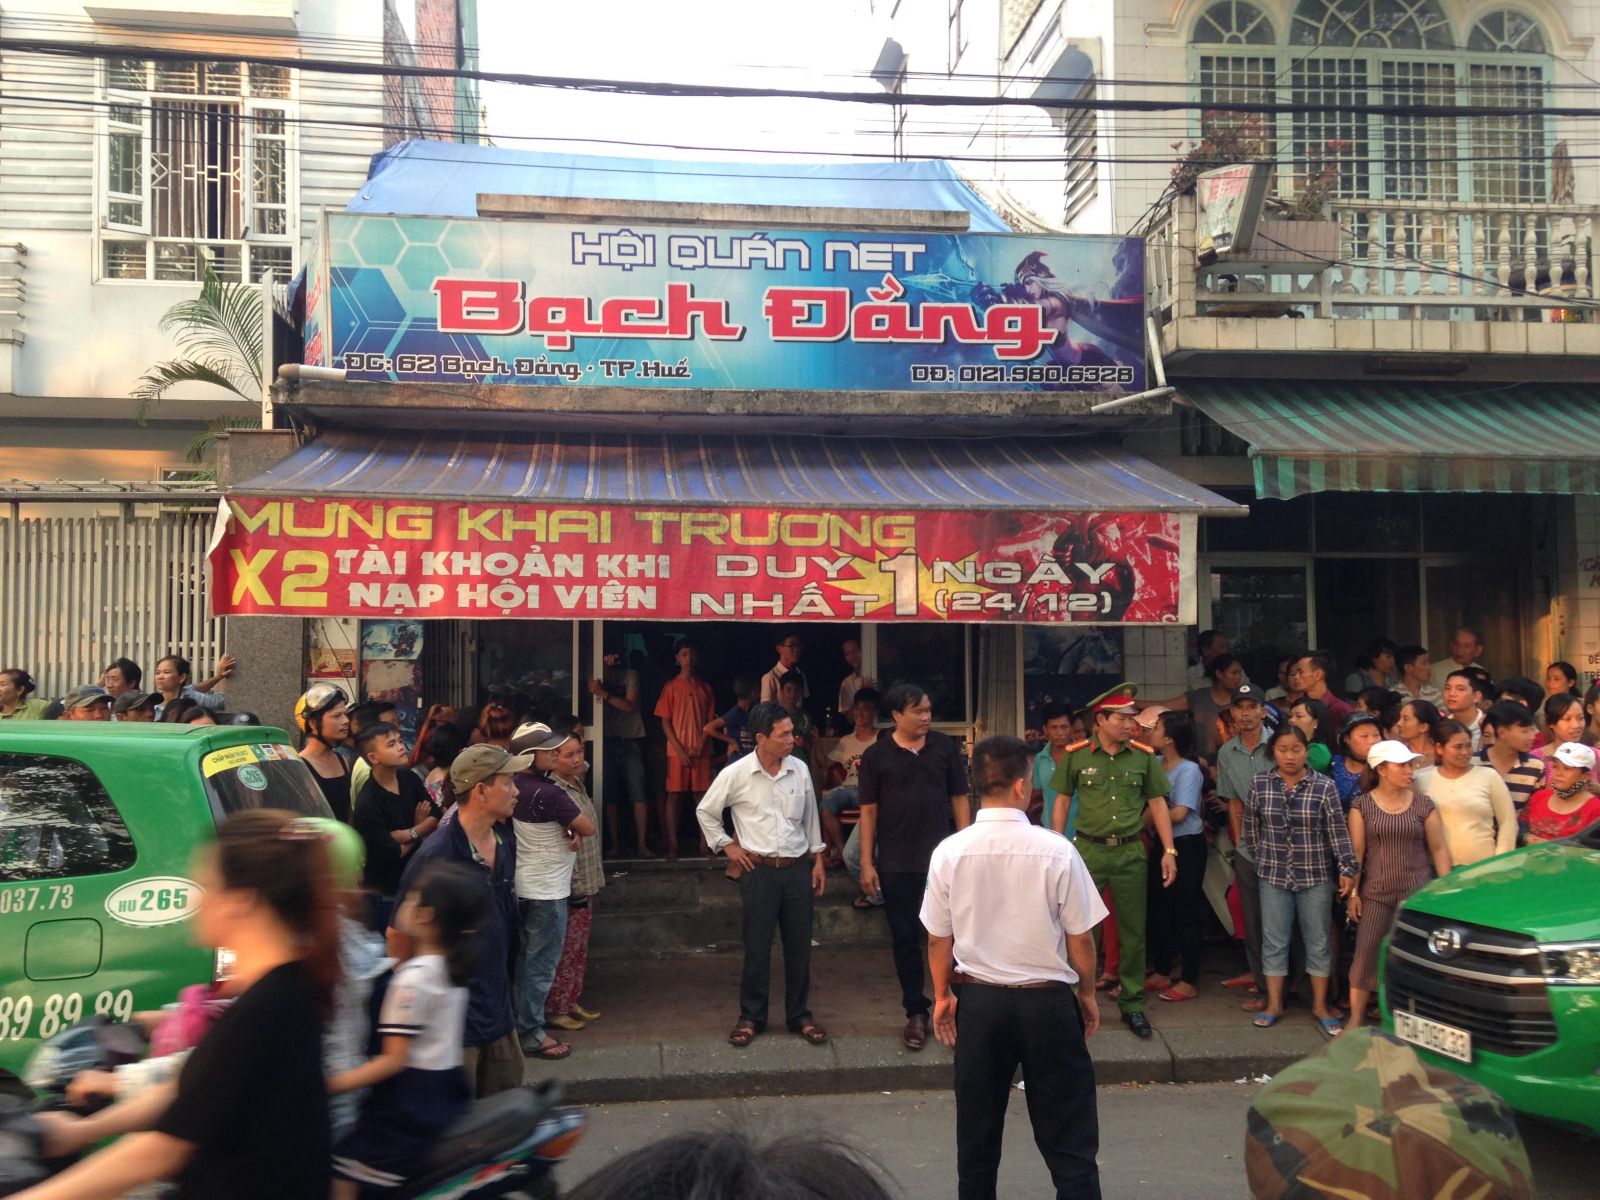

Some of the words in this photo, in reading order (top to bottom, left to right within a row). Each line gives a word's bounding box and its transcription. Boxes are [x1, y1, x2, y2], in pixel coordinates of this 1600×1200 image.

[572, 229, 656, 271] HỘI
[668, 232, 811, 270] QUÁN
[823, 240, 926, 272] NET
[431, 276, 746, 353] Bạch
[763, 272, 1058, 361] Đằng
[397, 354, 436, 373] 62
[441, 355, 510, 379] Bạch
[958, 365, 1134, 384] 0121.980.6328
[458, 507, 612, 544] KHAI
[230, 548, 329, 607] X2
[334, 544, 406, 575] TÀI
[421, 544, 583, 578] KHOẢN
[596, 554, 670, 578] KHI
[715, 554, 855, 579] DUY
[932, 553, 1116, 585] NGÀY
[349, 583, 444, 614] NẠP
[457, 579, 539, 614] HỘI
[555, 579, 657, 610] VIÊN
[690, 581, 879, 617] NHẤT
[879, 553, 918, 616] 1
[935, 589, 1112, 614] (24/12)
[118, 899, 136, 913] HU
[139, 888, 189, 912] 265
